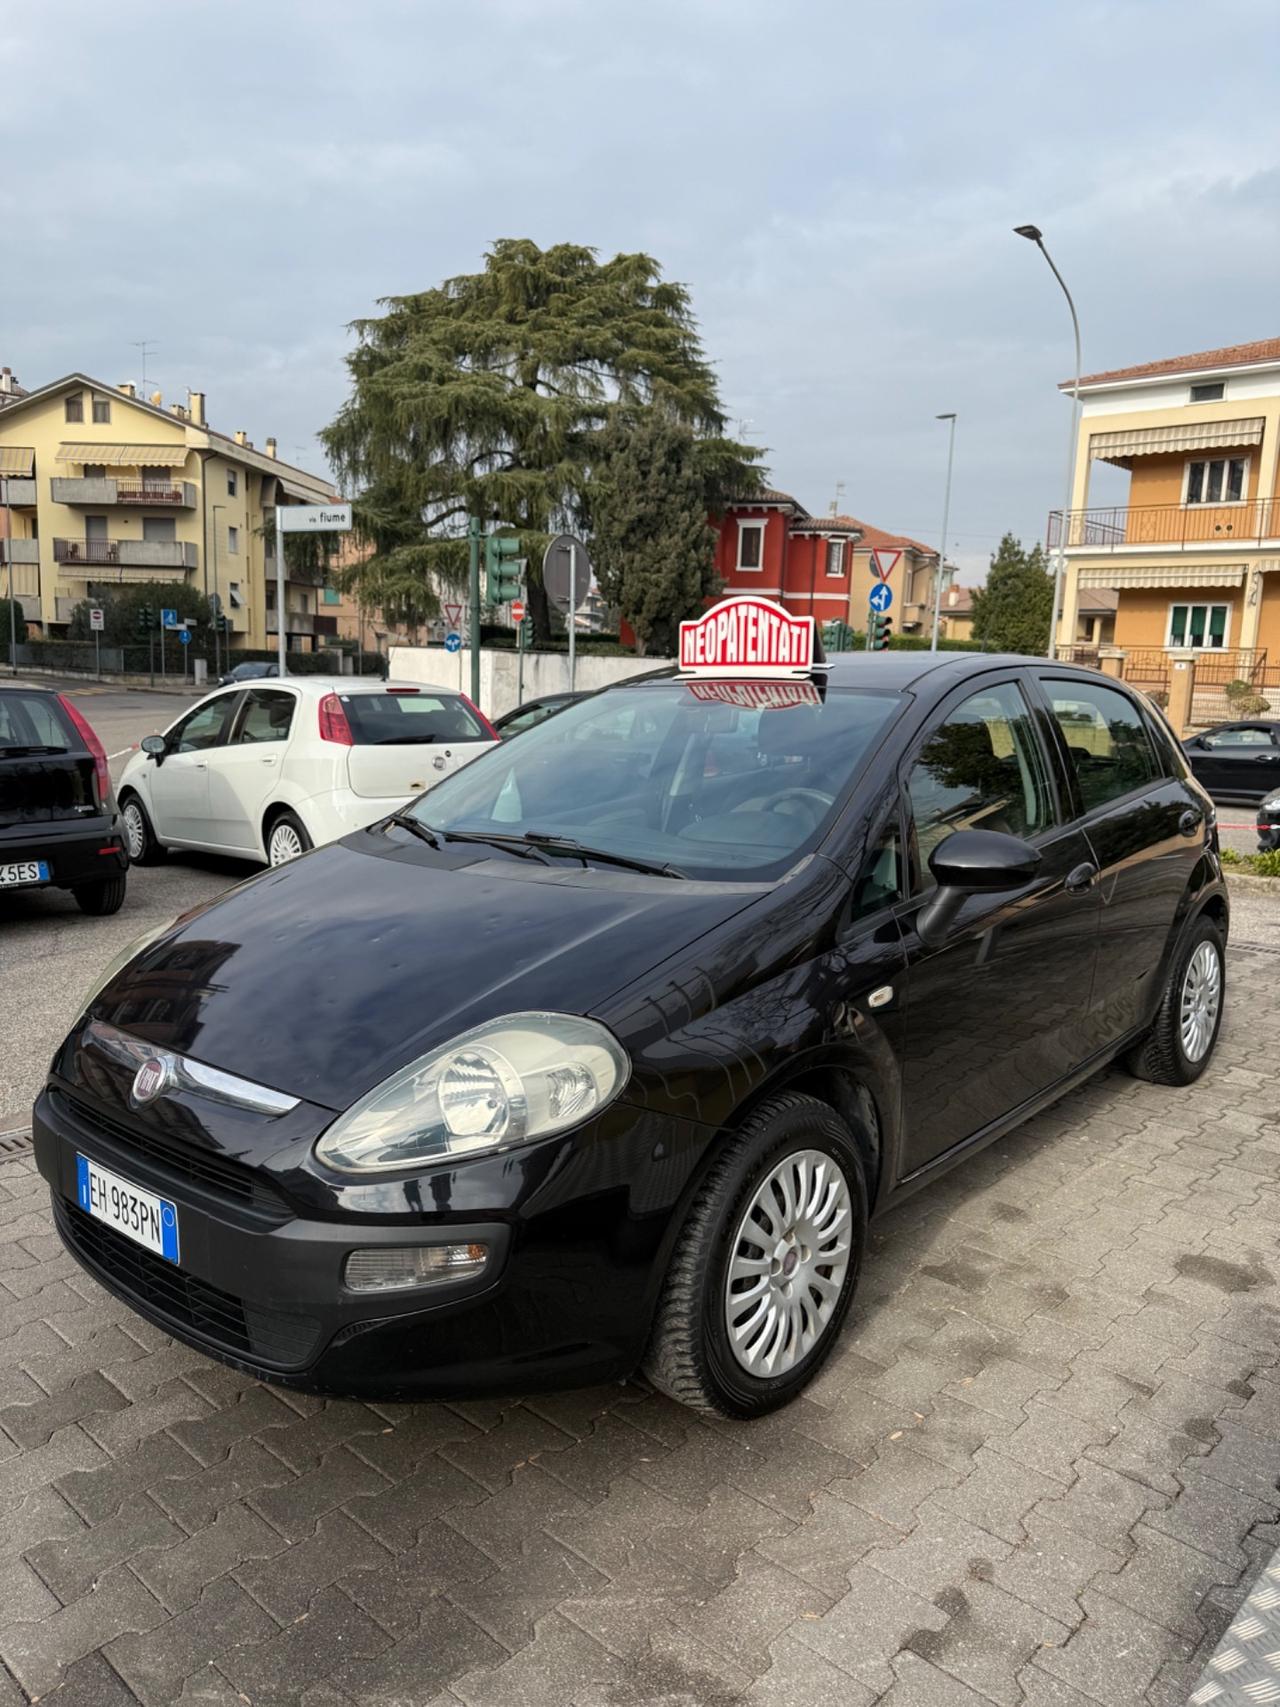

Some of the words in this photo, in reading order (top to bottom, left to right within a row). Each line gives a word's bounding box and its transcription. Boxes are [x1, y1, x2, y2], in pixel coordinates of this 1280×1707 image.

[320, 511, 346, 523] fiume
[683, 604, 807, 664] NEOPATENTATI
[90, 1172, 108, 1213] EH
[111, 1185, 160, 1244] 983PN
